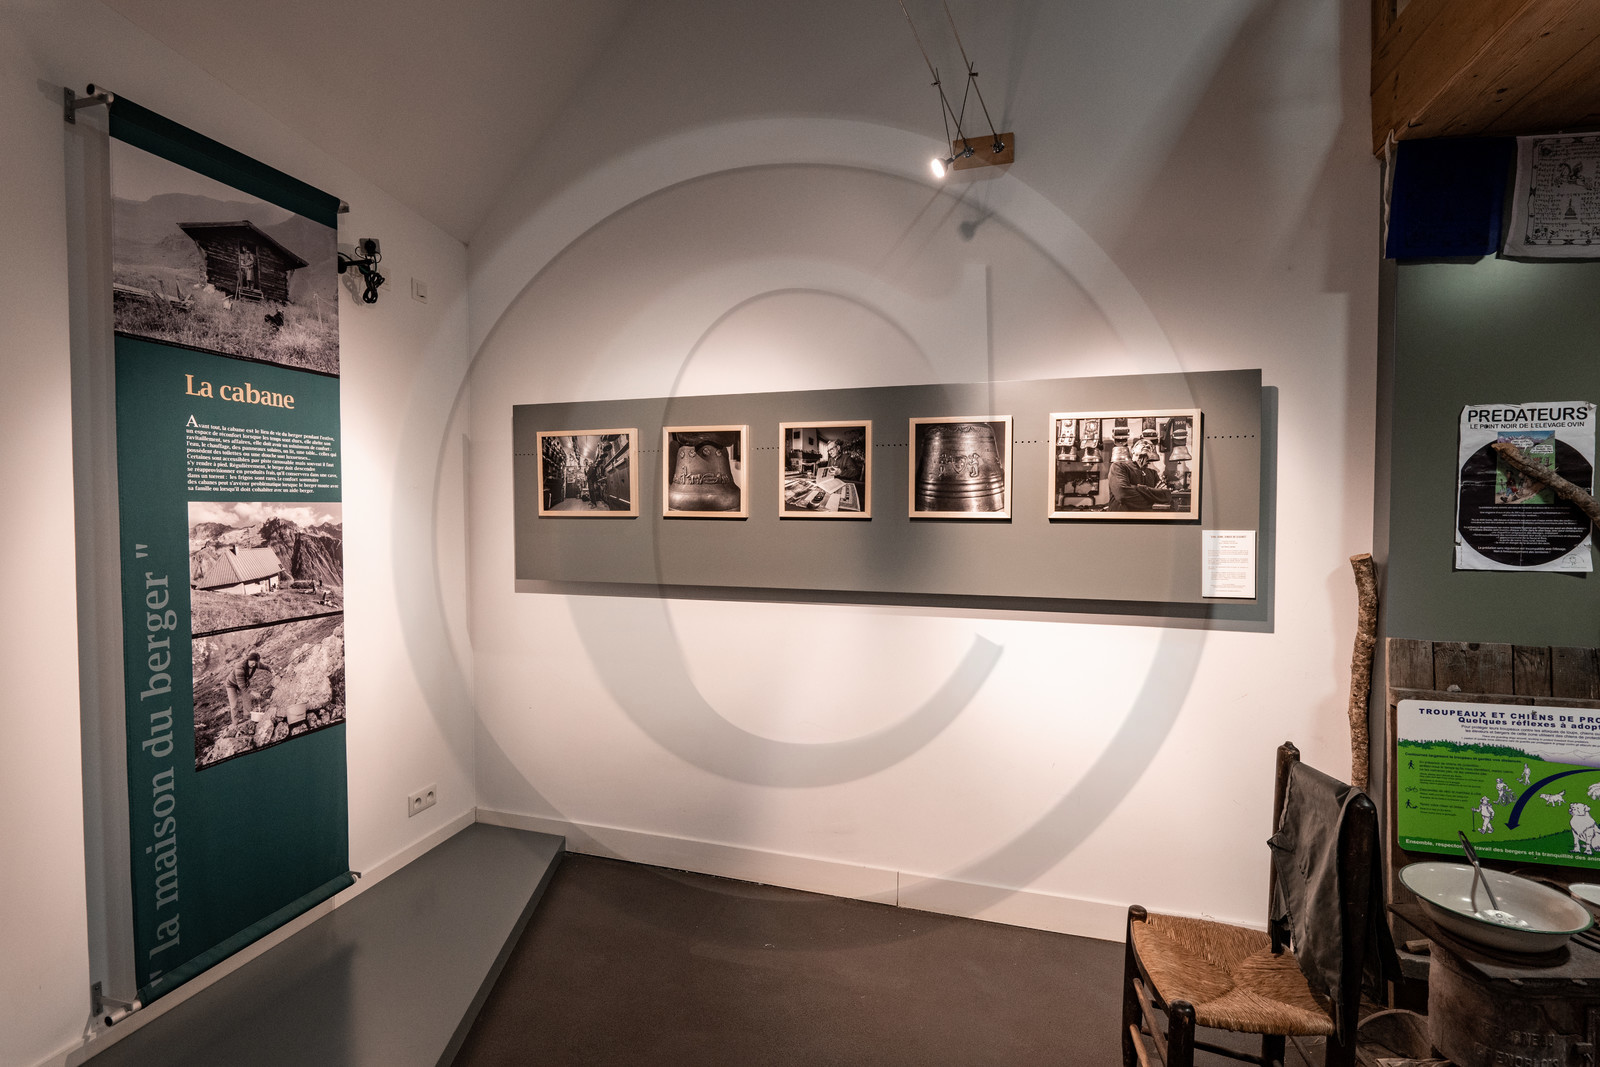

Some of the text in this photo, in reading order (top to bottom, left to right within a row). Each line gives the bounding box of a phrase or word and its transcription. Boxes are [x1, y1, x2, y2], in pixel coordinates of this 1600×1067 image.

[184, 374, 295, 410] La cabane
[1468, 406, 1588, 422] PREDATEURS
[140, 571, 178, 702] berger
[142, 706, 174, 759] du
[1419, 708, 1486, 718] TROUPEAUX
[1510, 713, 1553, 721] CHIENS
[1458, 717, 1507, 725] Quelques
[145, 766, 180, 909] maison
[149, 913, 180, 960] la
